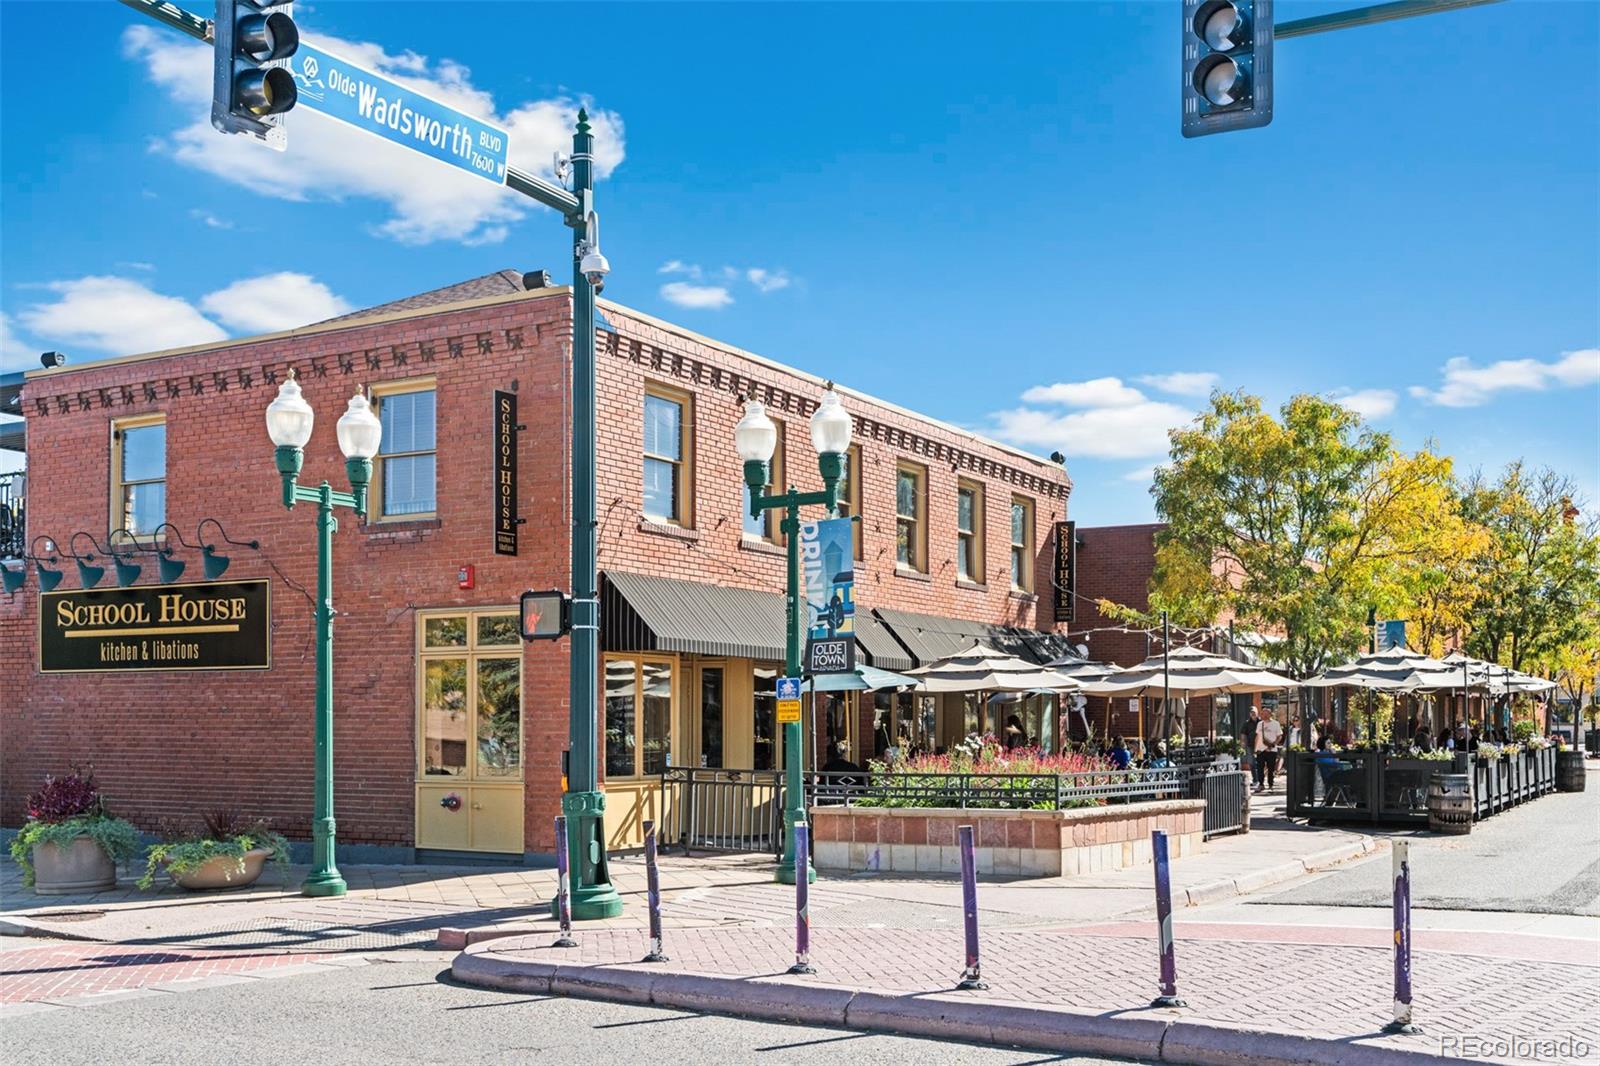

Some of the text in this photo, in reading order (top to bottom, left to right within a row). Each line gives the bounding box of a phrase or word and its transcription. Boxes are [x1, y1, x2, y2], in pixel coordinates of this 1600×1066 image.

[328, 68, 502, 160] Olde Wadsworth BLVD
[471, 151, 505, 178] 7600 W
[501, 398, 511, 467] SCHOOL
[500, 470, 512, 530] HOUSE
[57, 594, 247, 627] SCHOOL HOUSE
[101, 639, 200, 662] kitchen & libations
[814, 654, 845, 666] TOWN
[815, 643, 843, 655] OLDE
